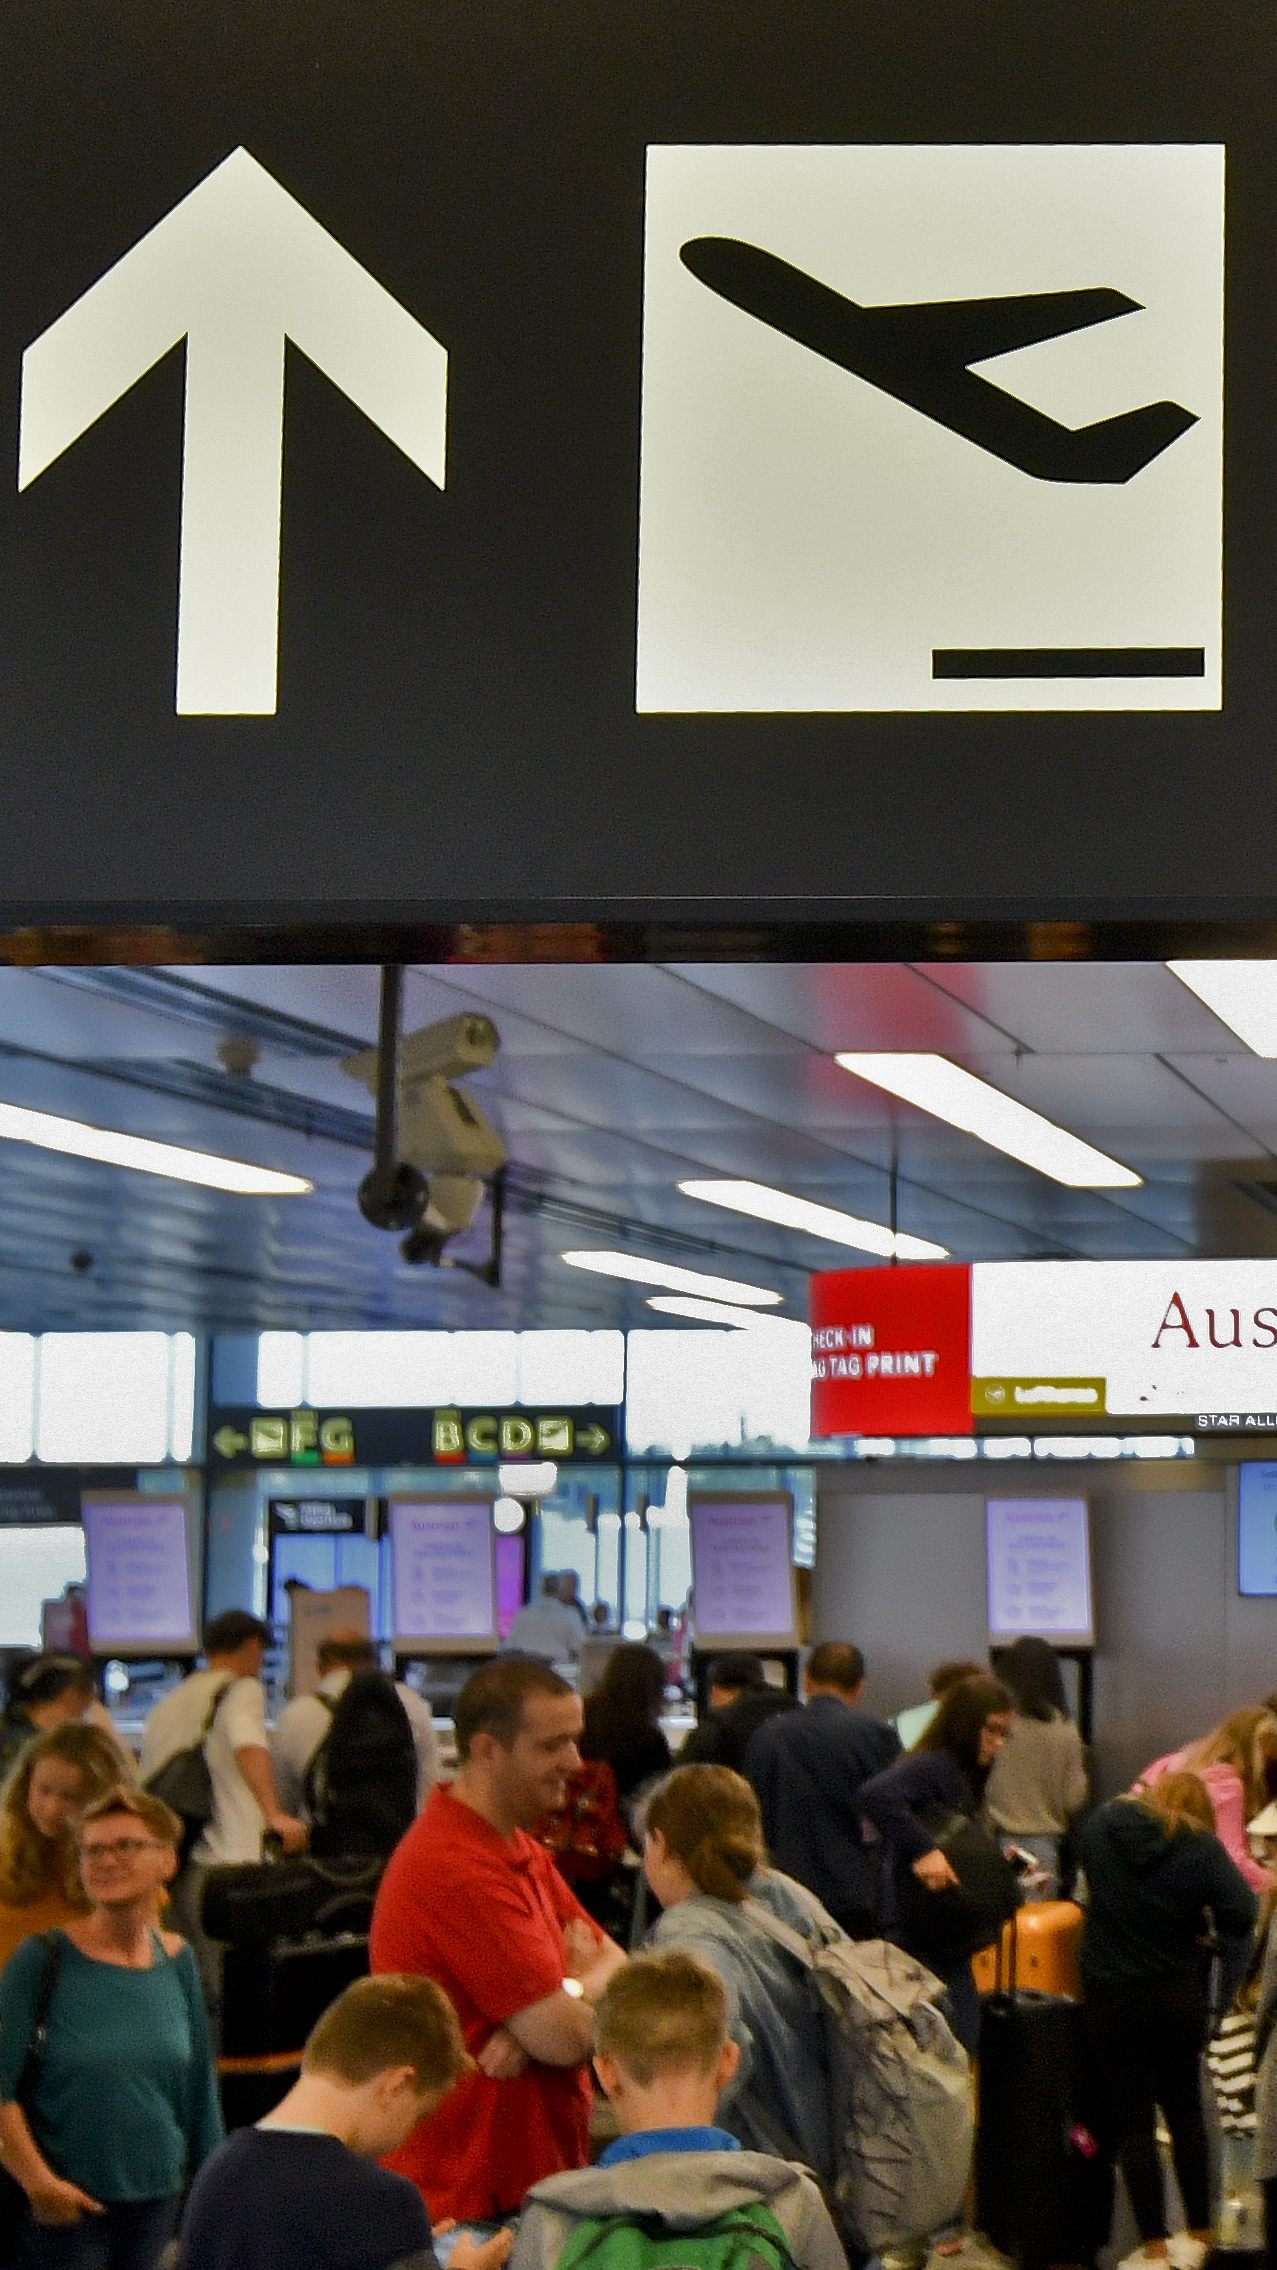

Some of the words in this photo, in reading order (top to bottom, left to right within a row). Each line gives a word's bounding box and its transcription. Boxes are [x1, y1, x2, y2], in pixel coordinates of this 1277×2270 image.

[812, 1327, 873, 1350] HECK-IN
[829, 1356, 862, 1377] TAG
[867, 1352, 937, 1376] PRINT
[1198, 1413, 1240, 1427] STAR
[321, 1415, 354, 1452] G
[468, 1415, 499, 1452] C
[501, 1415, 536, 1452] D
